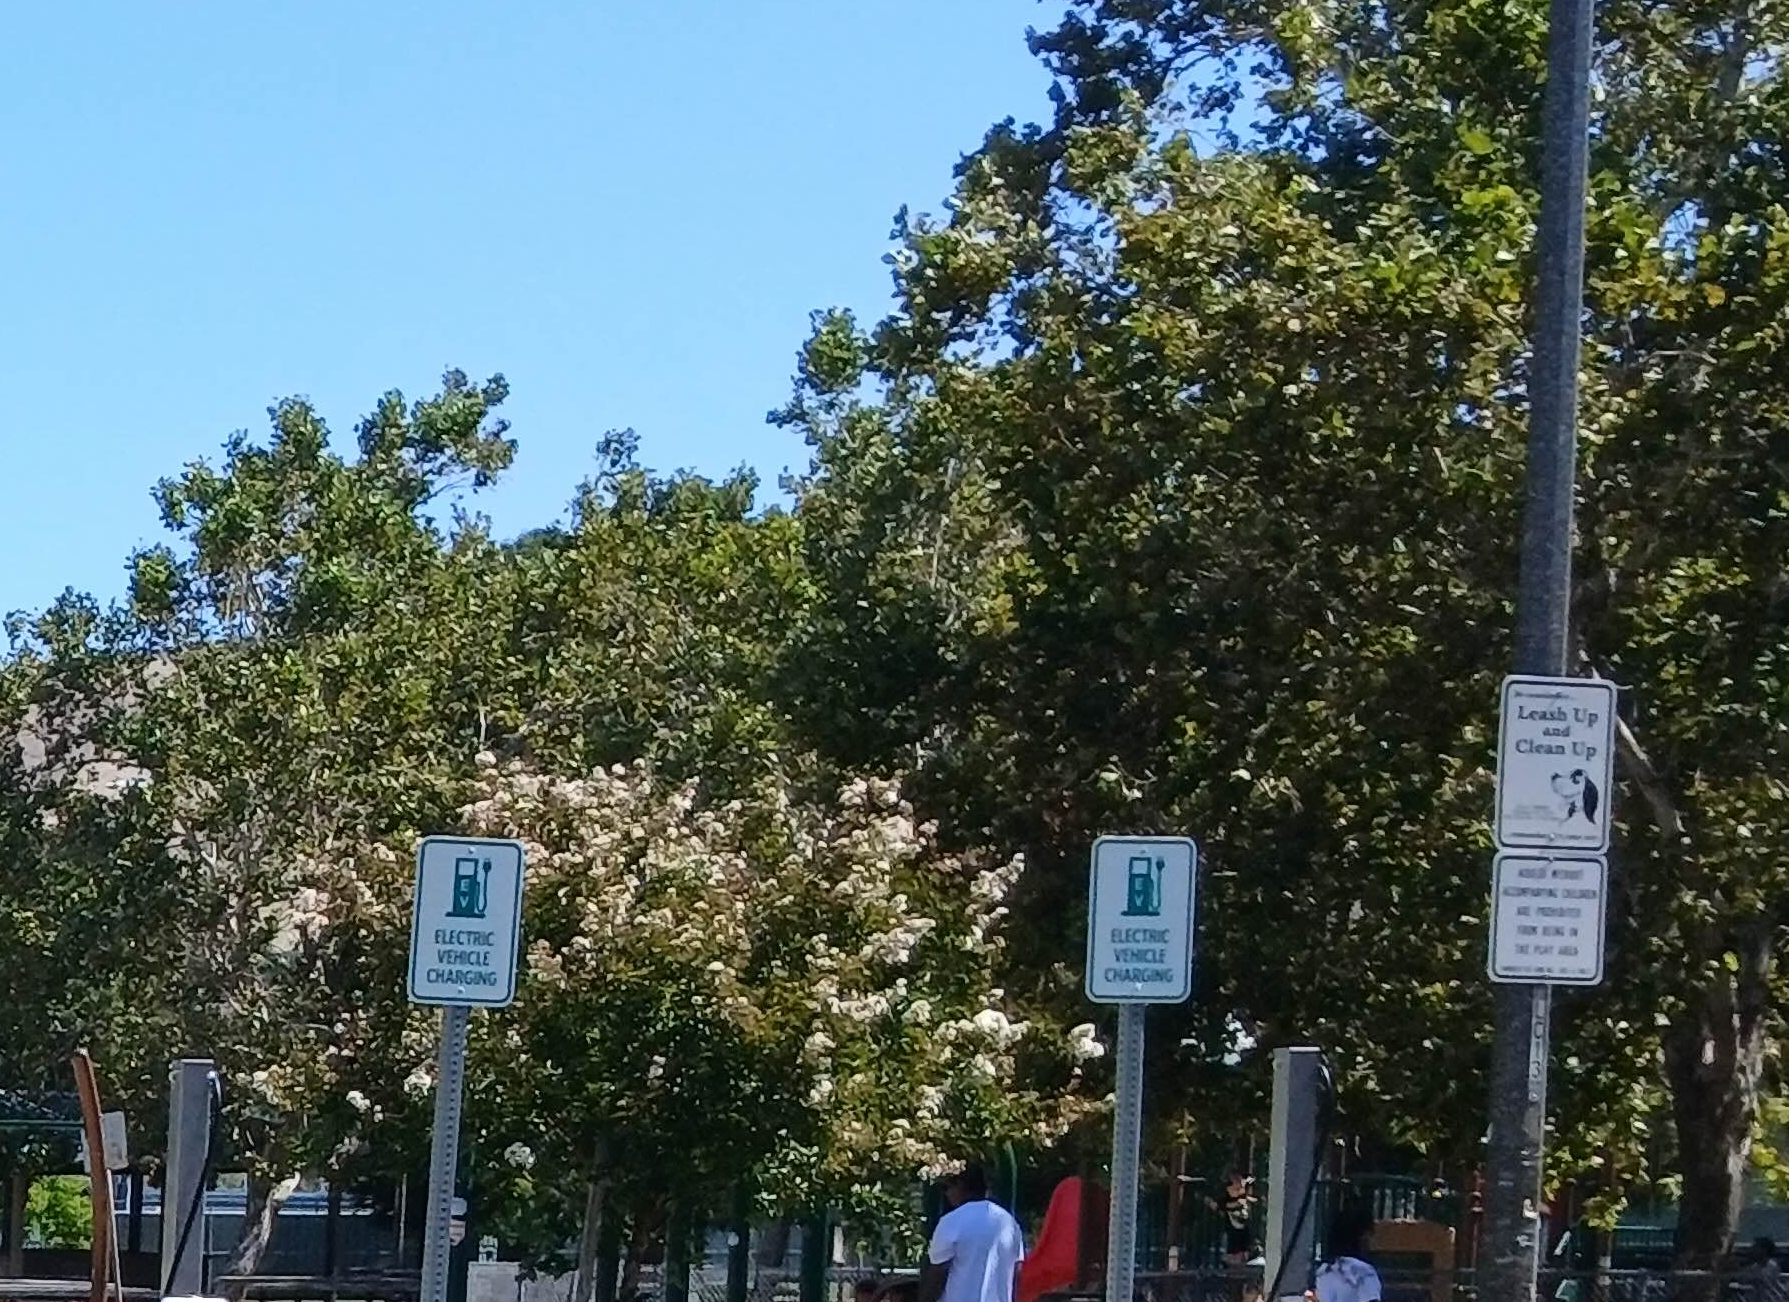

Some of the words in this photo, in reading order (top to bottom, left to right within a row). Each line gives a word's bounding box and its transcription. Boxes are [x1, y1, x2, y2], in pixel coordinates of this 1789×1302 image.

[1517, 705, 1567, 722] Leash
[1573, 708, 1598, 727] Up
[1542, 725, 1570, 737] and
[1515, 739, 1565, 754] Clean
[1572, 741, 1597, 761] Up
[435, 929, 495, 947] ELECTRIC
[1111, 928, 1169, 944] ELECTRIC
[437, 949, 490, 966] VEHICLE
[1113, 948, 1167, 963] VEHICLE
[426, 968, 497, 986] CHARGING
[1104, 968, 1174, 983] CHARGING
